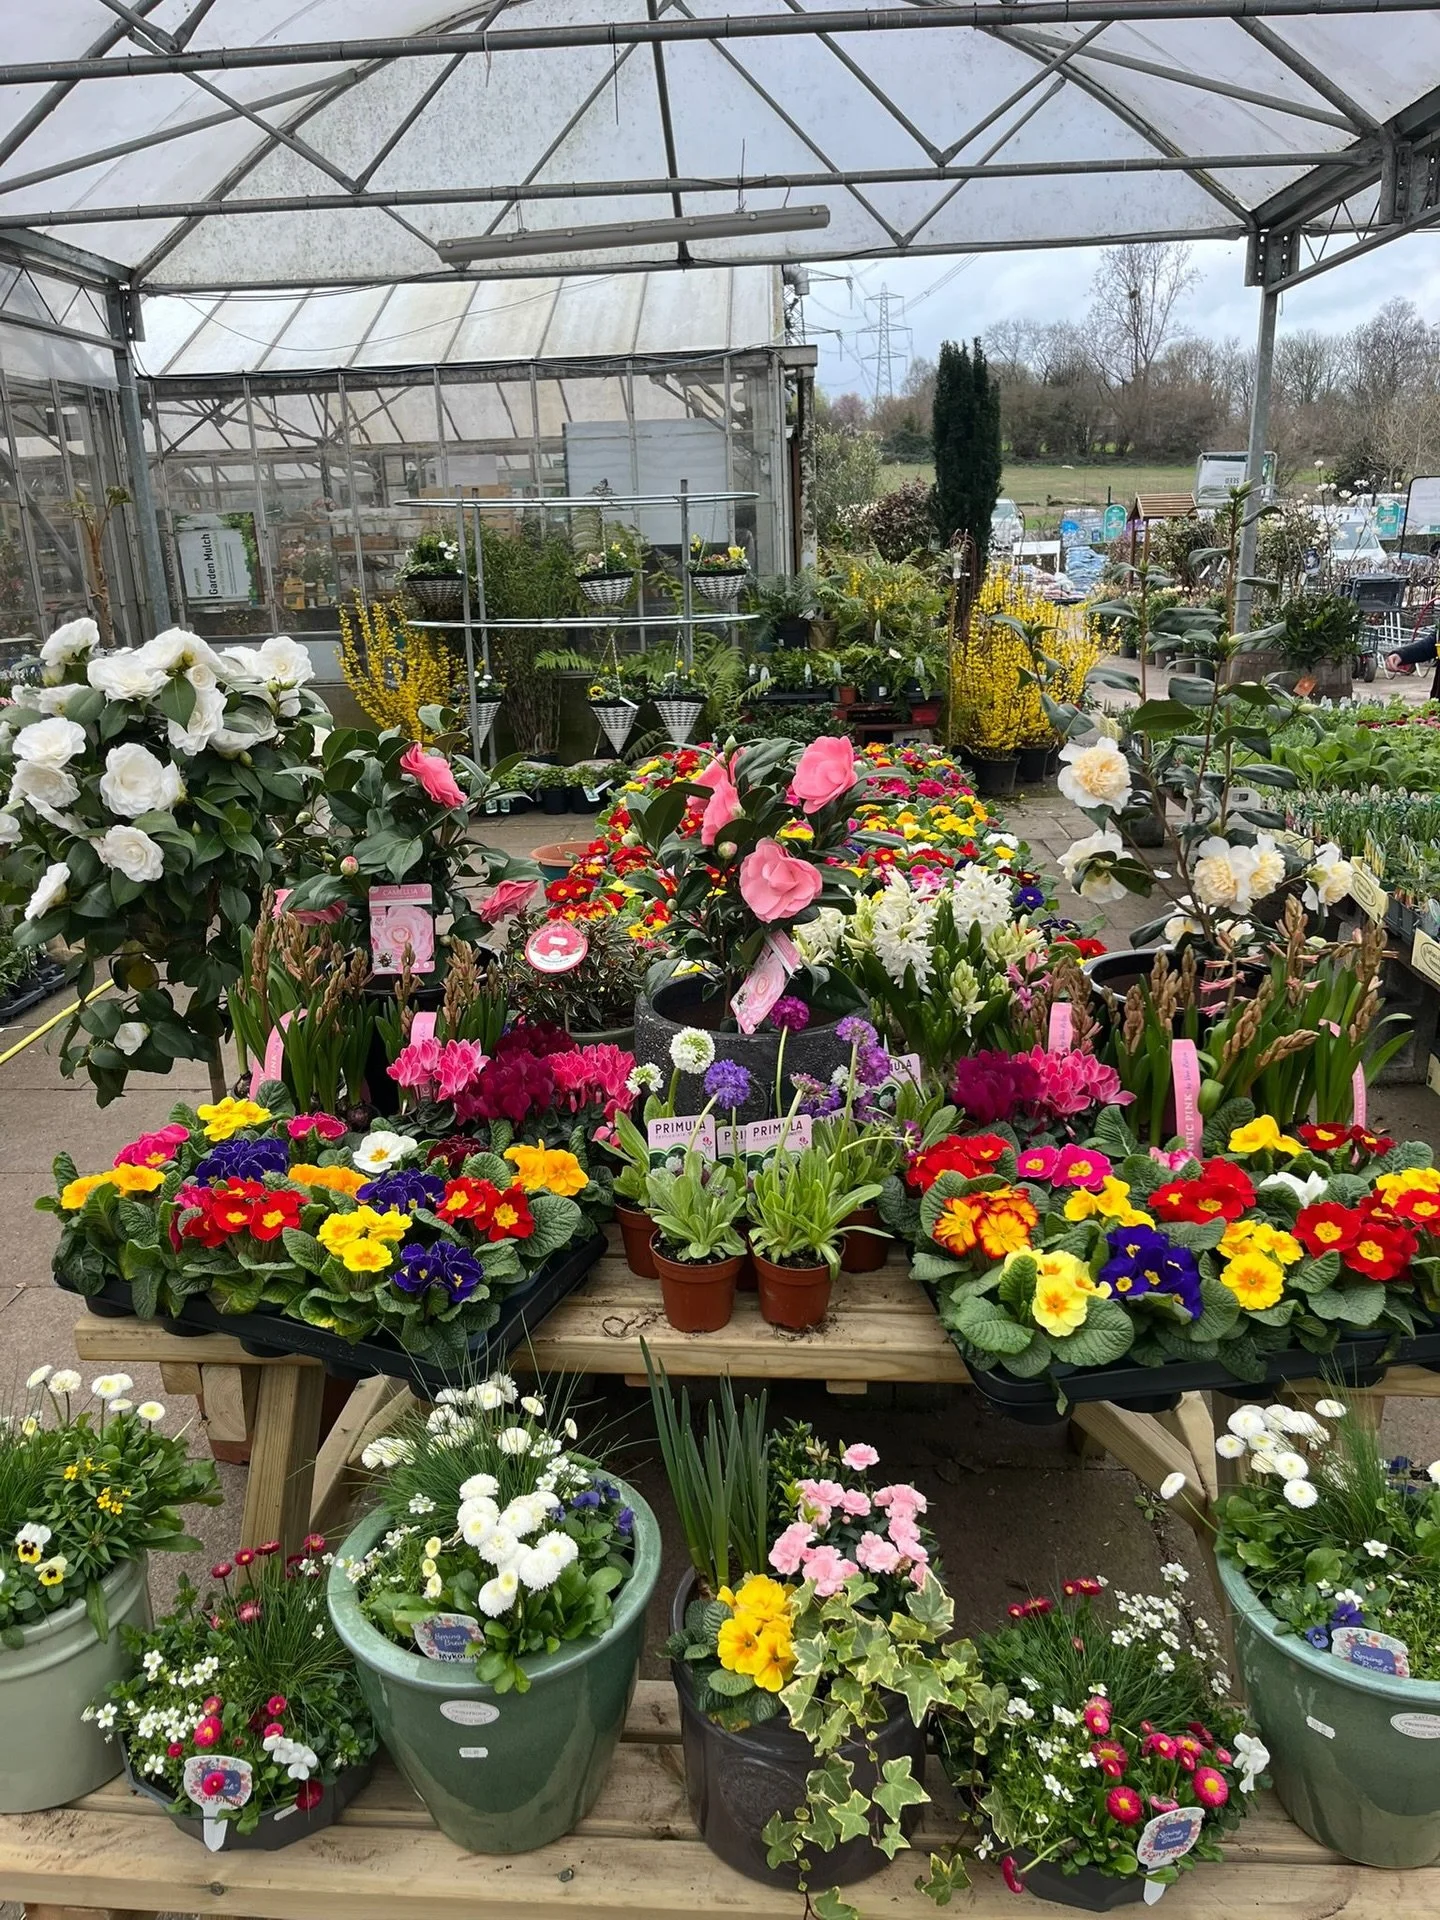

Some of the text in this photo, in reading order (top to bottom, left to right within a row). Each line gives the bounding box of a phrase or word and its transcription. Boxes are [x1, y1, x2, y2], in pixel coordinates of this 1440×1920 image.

[201, 533, 218, 596] Garden Mulch
[1183, 1093, 1194, 1121] PINK
[753, 1119, 803, 1137] PRIMLA
[434, 1632, 461, 1641] Spring
[1353, 1650, 1384, 1666] Spring
